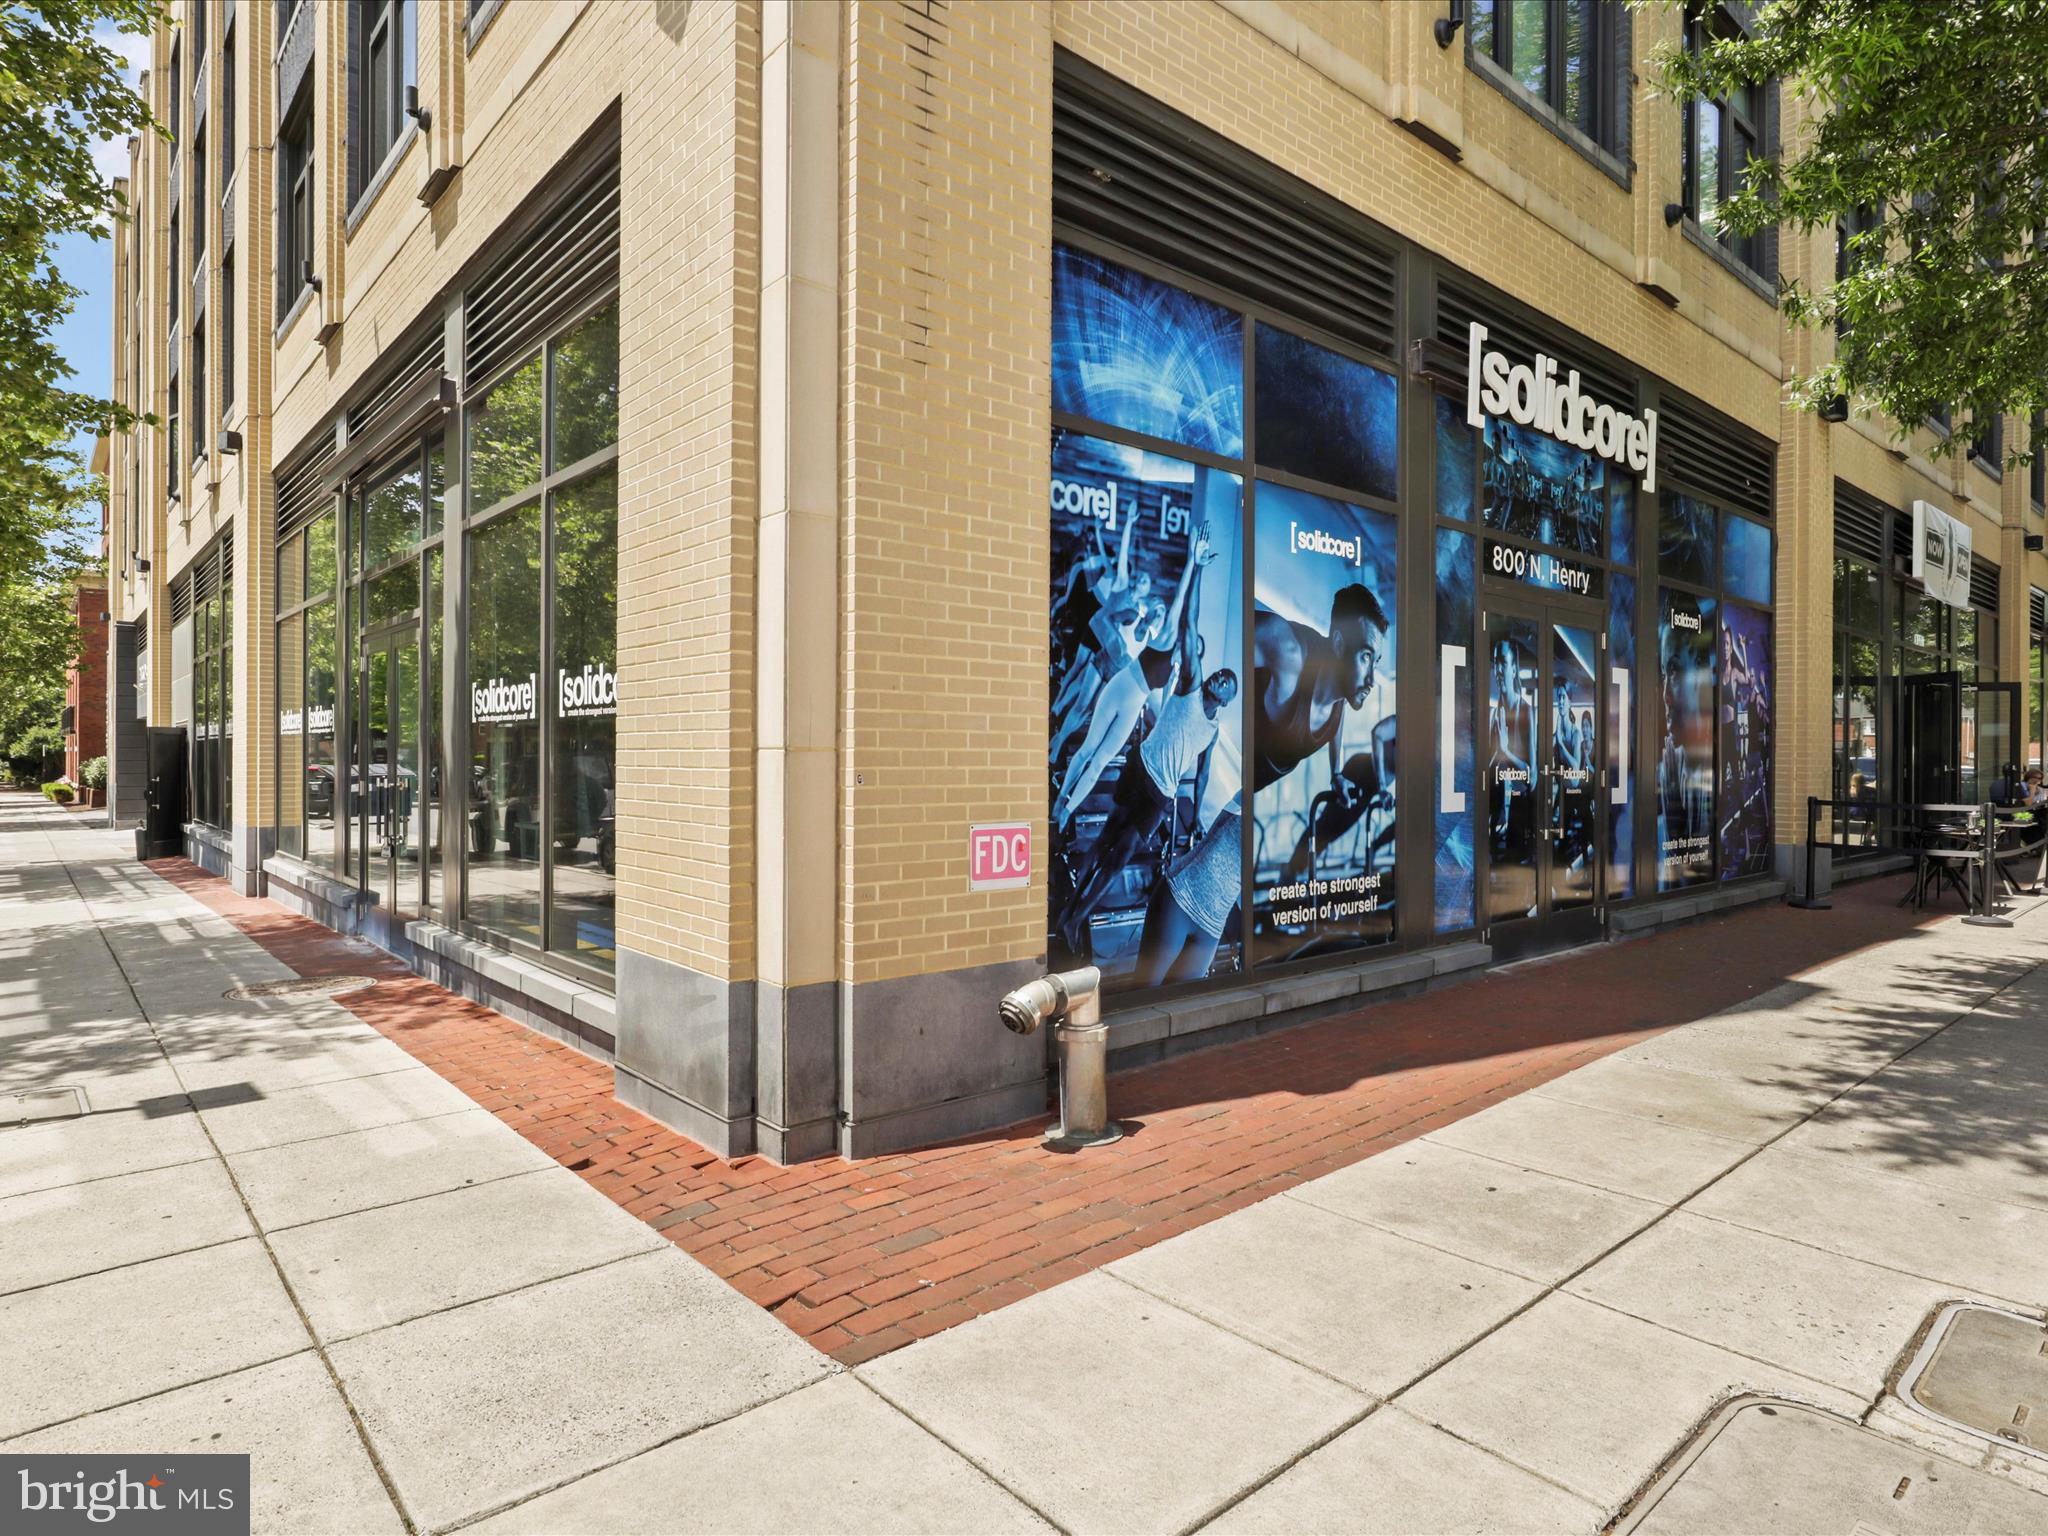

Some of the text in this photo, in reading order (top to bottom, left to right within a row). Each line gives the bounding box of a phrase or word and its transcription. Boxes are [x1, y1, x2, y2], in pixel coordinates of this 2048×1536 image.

[1493, 545, 1590, 594] 800 N. Henry
[975, 834, 1027, 875] FDC
[1268, 872, 1381, 901] create the strongest
[1272, 895, 1378, 926] version of yourself
